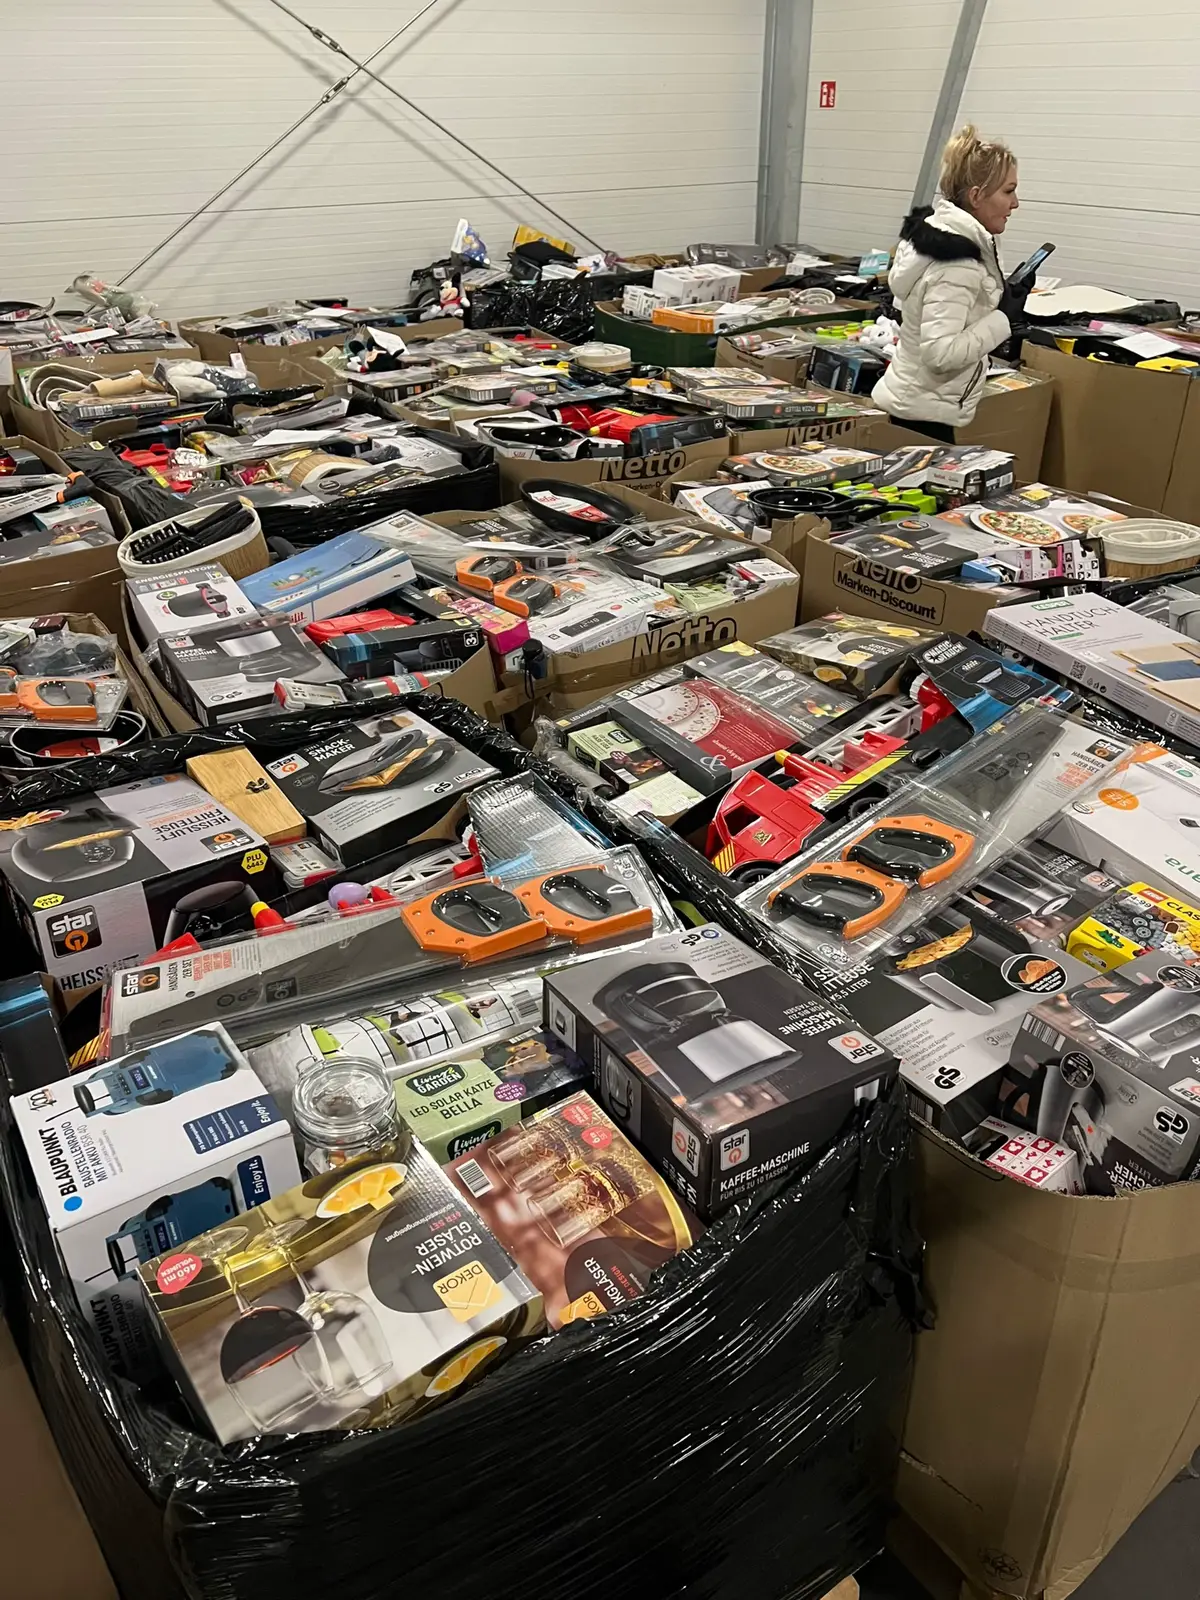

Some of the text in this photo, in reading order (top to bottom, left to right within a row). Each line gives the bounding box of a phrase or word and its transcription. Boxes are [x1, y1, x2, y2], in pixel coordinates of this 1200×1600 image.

[600, 451, 688, 480] Netto
[624, 480, 667, 492] arken-D
[799, 477, 813, 487] PIZZA
[134, 563, 219, 584] ENERGIESPARTOPF
[836, 570, 937, 621] Marken-Discount
[1034, 600, 1073, 610] KESPER
[1020, 603, 1121, 629] HANDTUCH-
[1034, 619, 1101, 638] HALTER
[466, 633, 479, 647] 3+
[631, 616, 738, 670] Netto
[930, 640, 954, 660] MAGIC
[176, 649, 219, 659] MASCHINE
[938, 643, 967, 662] TRUCK
[308, 738, 350, 758] SNACK-
[314, 743, 356, 763] MAKER
[1095, 739, 1123, 753] star
[270, 754, 297, 771] star
[1070, 750, 1106, 769] HANDSÄGEN
[432, 780, 453, 796] GS
[151, 808, 224, 834] FRITTEUSE
[155, 814, 231, 842] HEISSLUFT-
[213, 835, 252, 852] star
[245, 852, 263, 864] PLU
[245, 857, 264, 871] 6445
[1129, 895, 1153, 909] 4-99
[51, 910, 95, 936] star
[680, 931, 702, 947] GS
[121, 970, 140, 996] star
[168, 961, 179, 993] HANDSÄGEN
[848, 977, 872, 995] LITER
[778, 1010, 835, 1036] MASCHINE
[800, 1015, 845, 1038] KAFFEE-
[848, 1042, 878, 1060] star
[411, 1070, 449, 1089] Living
[417, 1072, 463, 1095] GARDEN
[933, 1064, 962, 1091] GS
[409, 1103, 431, 1120] LED
[431, 1092, 464, 1112] SOLAR
[462, 1078, 496, 1099] KATZE
[439, 1098, 483, 1120] BELLA
[253, 1107, 272, 1124] Enjoy
[1154, 1111, 1188, 1137] GS
[685, 1134, 698, 1166] star
[724, 1132, 748, 1154] star
[38, 1126, 79, 1198] BLAUPUNKT
[60, 1120, 96, 1189] BAUSTELLENRADIO
[249, 1158, 259, 1171] it.
[719, 1141, 811, 1193] KAFFEE-MASCHINE
[765, 1164, 790, 1182] TASSEN
[252, 1167, 266, 1195] Enjoy
[428, 1218, 446, 1232] SET
[415, 1220, 474, 1257] GLÄSER
[410, 1231, 485, 1278] ROTWEIN-
[159, 1256, 197, 1278] VOLUMEN
[162, 1262, 199, 1287] 460 ml
[610, 1264, 630, 1290] DESIGN
[436, 1263, 485, 1297] DEKOR
[582, 1293, 606, 1318] KOR
